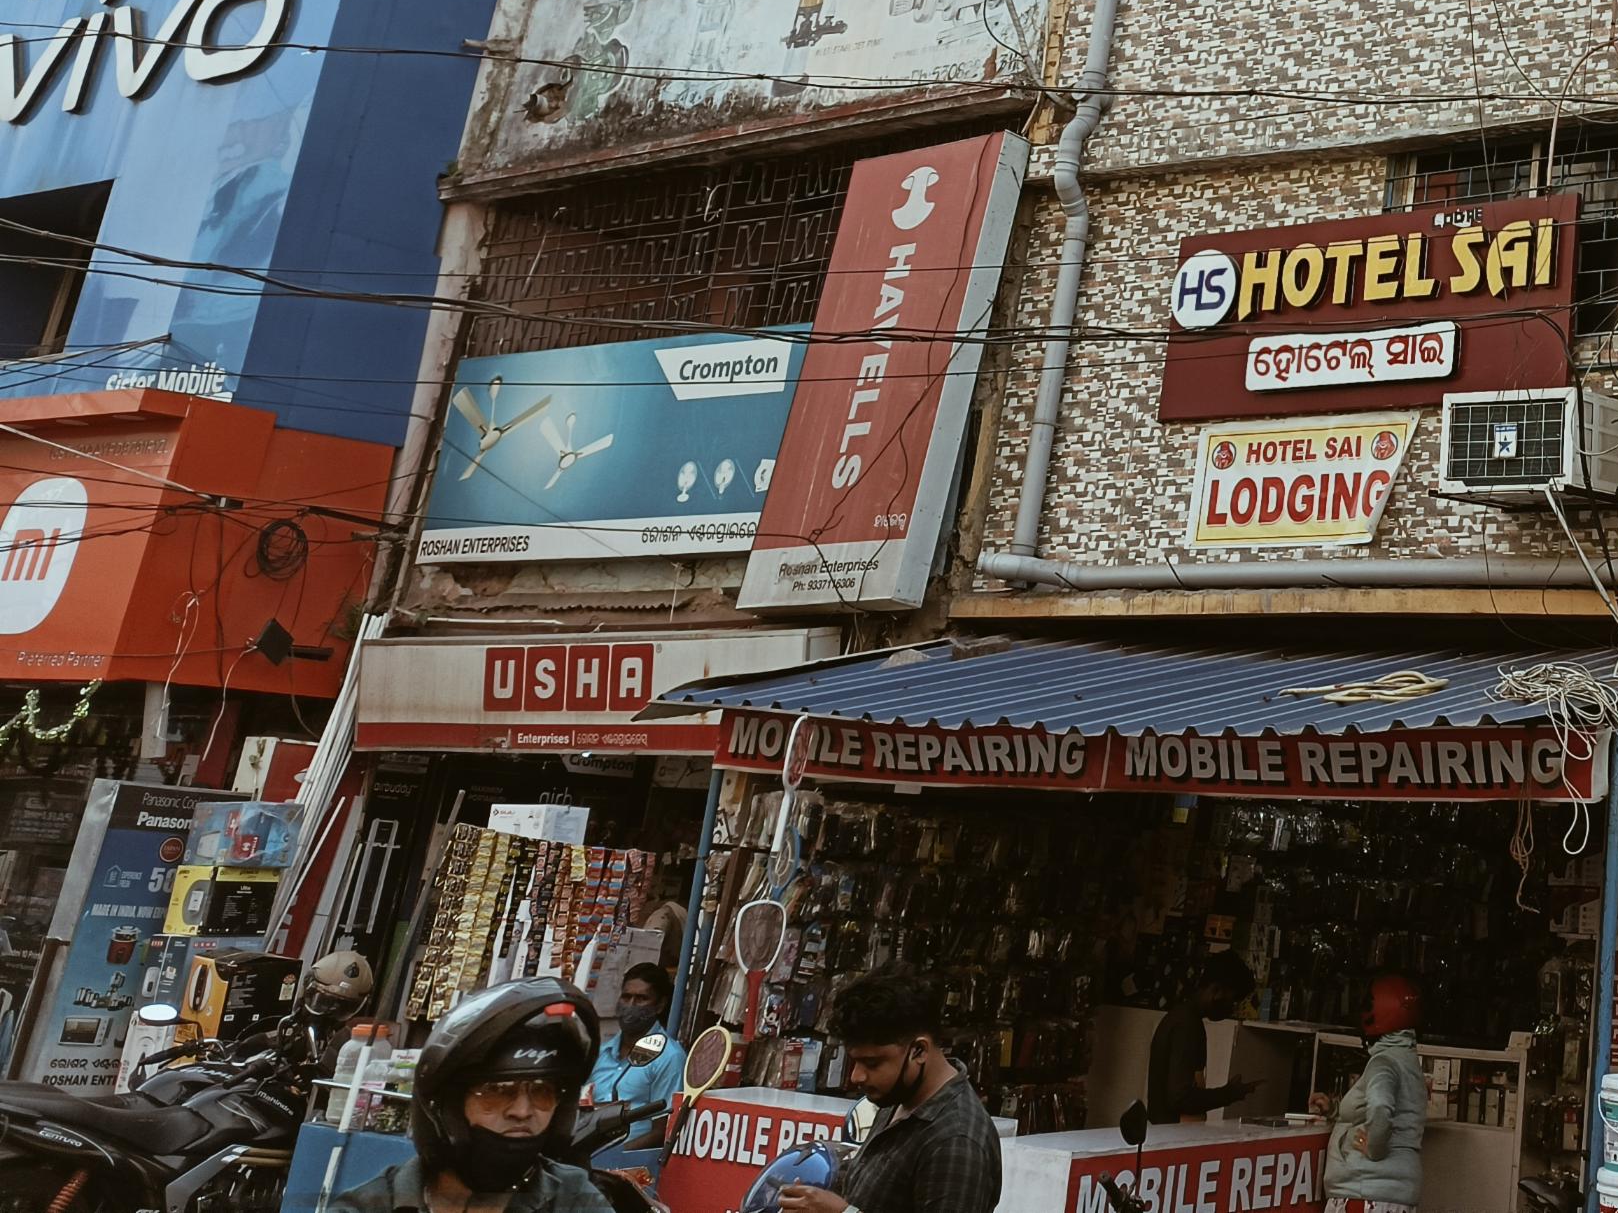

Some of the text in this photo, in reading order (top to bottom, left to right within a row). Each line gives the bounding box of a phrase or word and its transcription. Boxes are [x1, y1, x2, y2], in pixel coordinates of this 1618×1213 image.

[1237, 217, 1556, 321] HOTEL SAI
[1177, 266, 1228, 312] HS
[678, 355, 779, 384] Crompton
[832, 242, 916, 489] HAVELLS
[1254, 332, 1445, 382] ହୋଟେଲ୍ ସାଇ
[158, 362, 226, 394] Mobile
[1245, 436, 1362, 464] HOTEL SAI
[1206, 470, 1390, 527] LODGING
[419, 535, 530, 555] ROSHAN ENTERPRISES
[779, 559, 879, 577] Roshan Enterprises
[17, 651, 106, 667] Preferred Partner
[492, 657, 643, 700] USHA
[517, 733, 569, 746] Enterprises
[728, 715, 1085, 777] MOILE REPAIRING
[1126, 735, 1565, 786] MOBILE REPAIRING
[143, 792, 181, 808] Panasonic
[42, 1074, 88, 1086] ROSHAN
[671, 1108, 772, 1166] MOBILE
